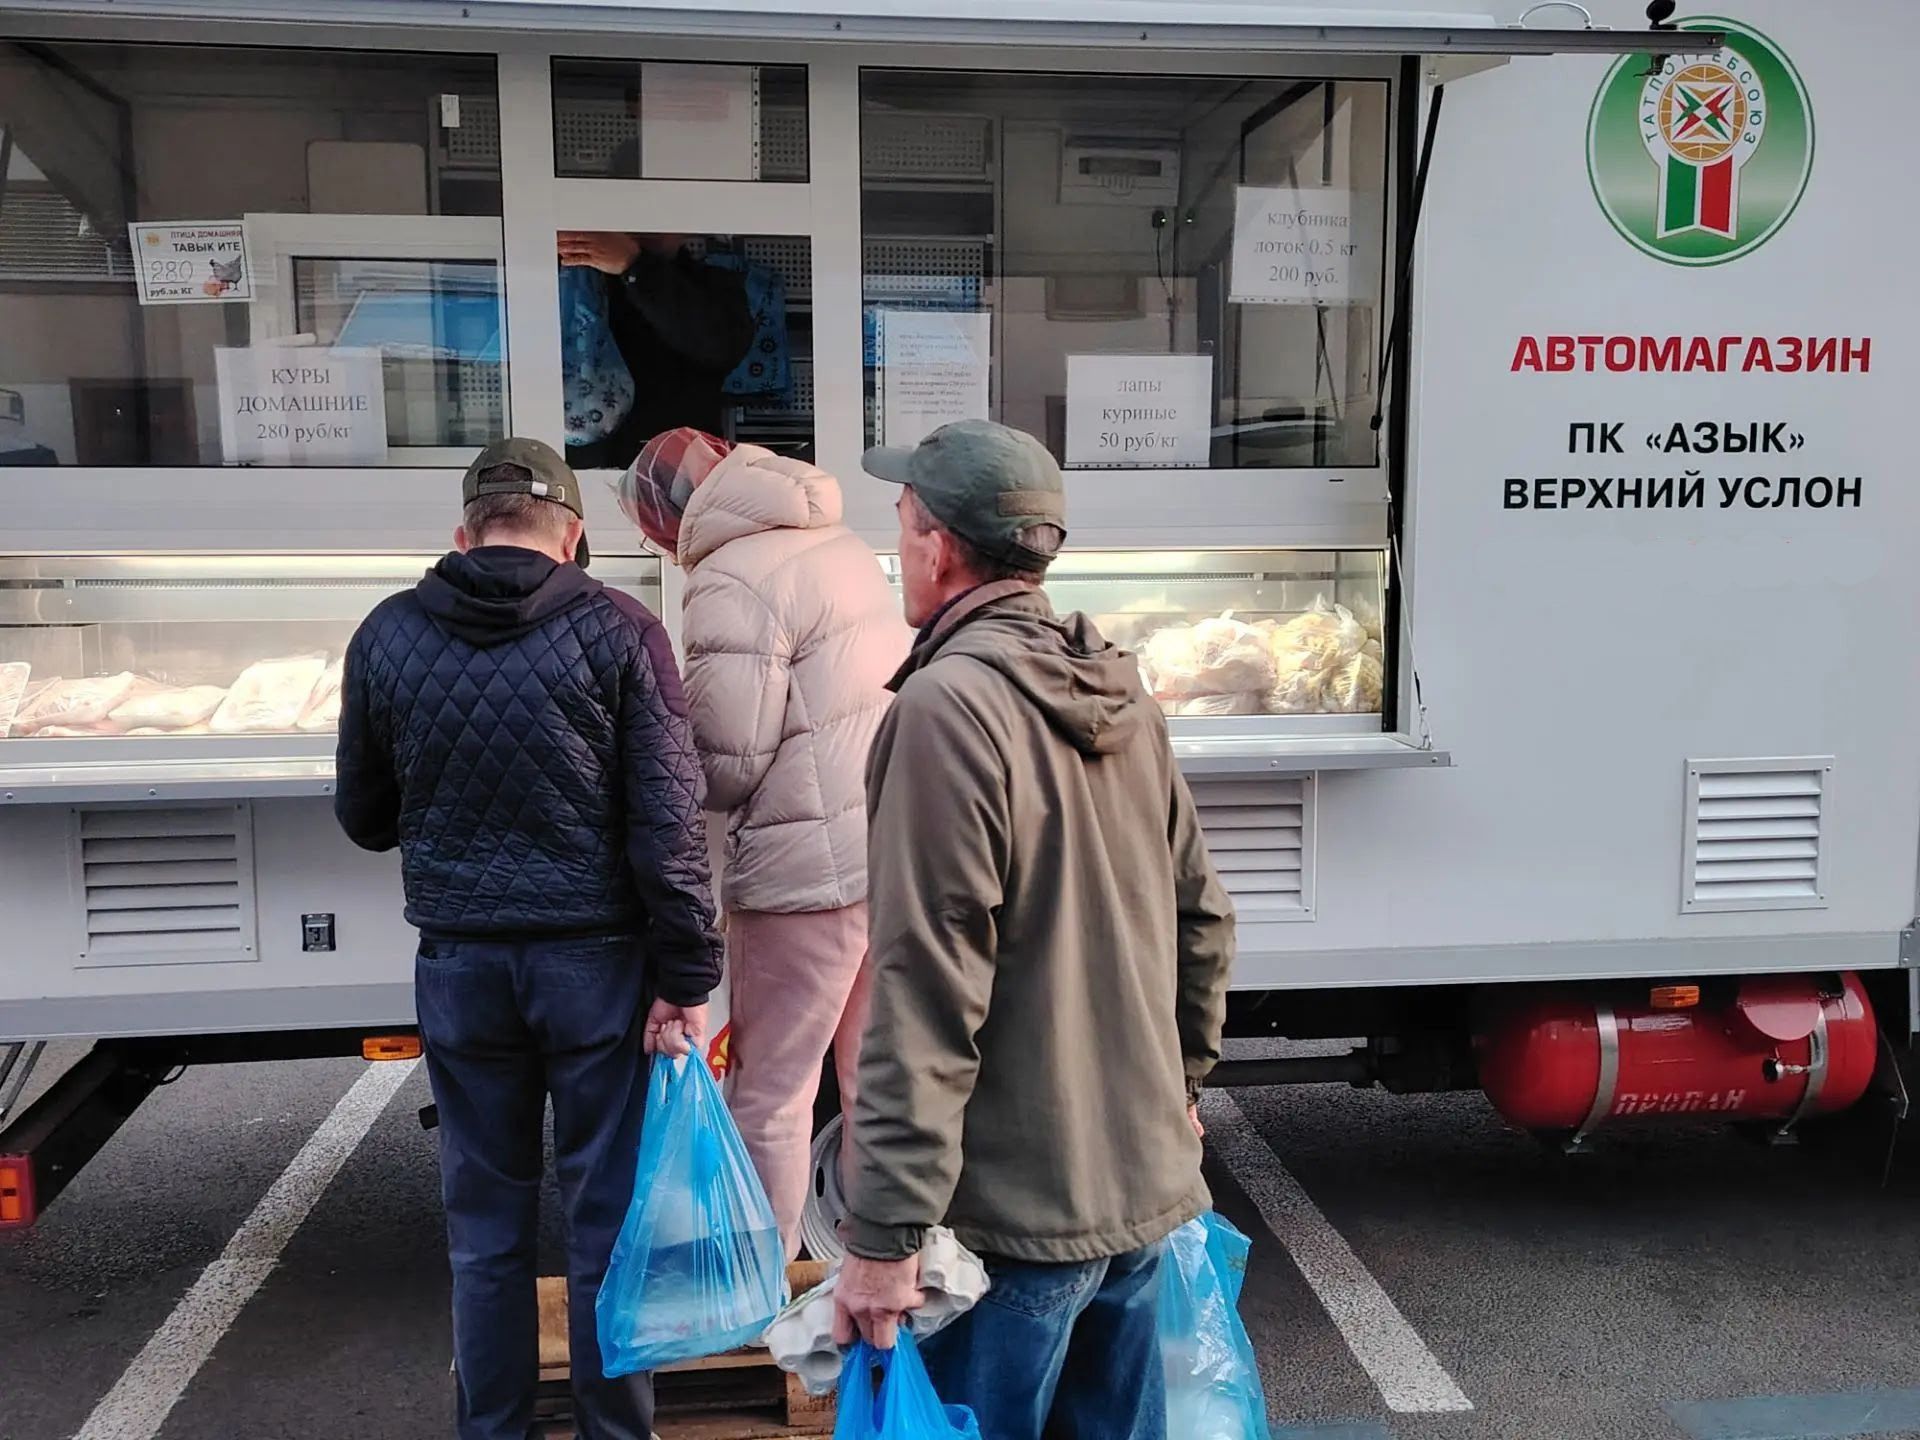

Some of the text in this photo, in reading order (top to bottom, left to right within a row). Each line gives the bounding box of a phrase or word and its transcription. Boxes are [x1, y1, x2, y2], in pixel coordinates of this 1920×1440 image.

[1268, 210, 1349, 229] клубника
[173, 242, 241, 252] ТАВЫК ИТЕ
[1254, 241, 1304, 255] лоток
[1340, 243, 1357, 257] кг
[151, 260, 193, 282] 280
[1269, 266, 1338, 287] 200 руб.
[1511, 336, 1871, 372] АВТОМАГАЗИН
[272, 369, 330, 384] КУРЫ
[1117, 380, 1162, 394] лапы
[237, 396, 368, 415] ДОМАШНИЕ
[1102, 407, 1176, 423] куриные
[258, 422, 351, 443] 280 руб/кг
[1099, 431, 1178, 451] 50 руб/кг
[1569, 422, 1805, 453] ПК «АЗЫК»
[1503, 470, 1862, 509] ВЕРХНИЙ УСЛОН
[1615, 1089, 1747, 1114] ПРОПАН
